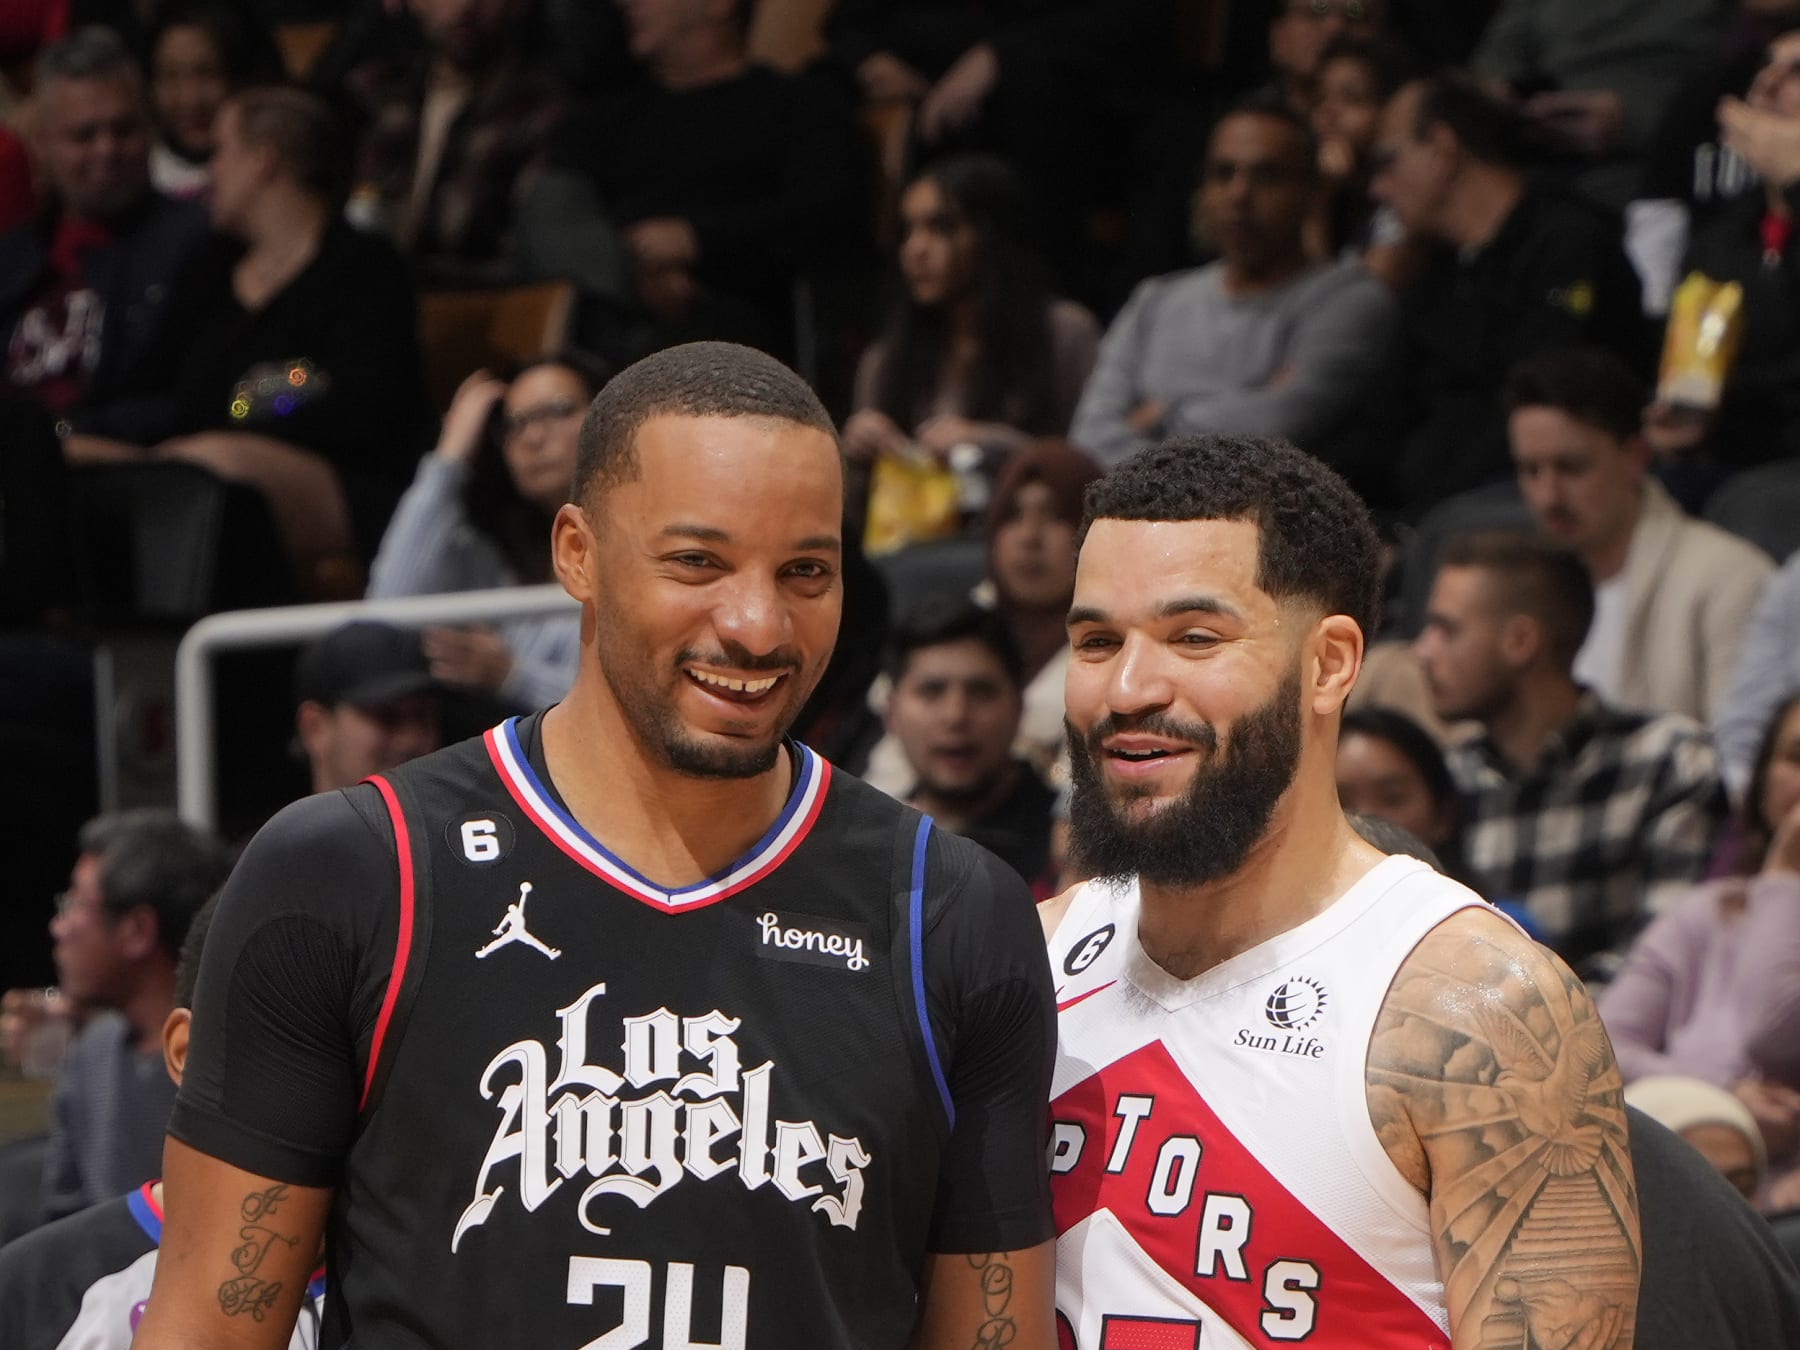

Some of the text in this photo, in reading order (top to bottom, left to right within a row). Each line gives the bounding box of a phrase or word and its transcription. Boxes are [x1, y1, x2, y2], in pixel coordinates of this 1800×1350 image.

[461, 819, 500, 862] 6
[756, 912, 870, 971] honey
[1070, 930, 1109, 970] 6
[548, 983, 742, 1097] Los
[1233, 1028, 1325, 1059] Sun Life
[452, 1039, 872, 1255] Angeles
